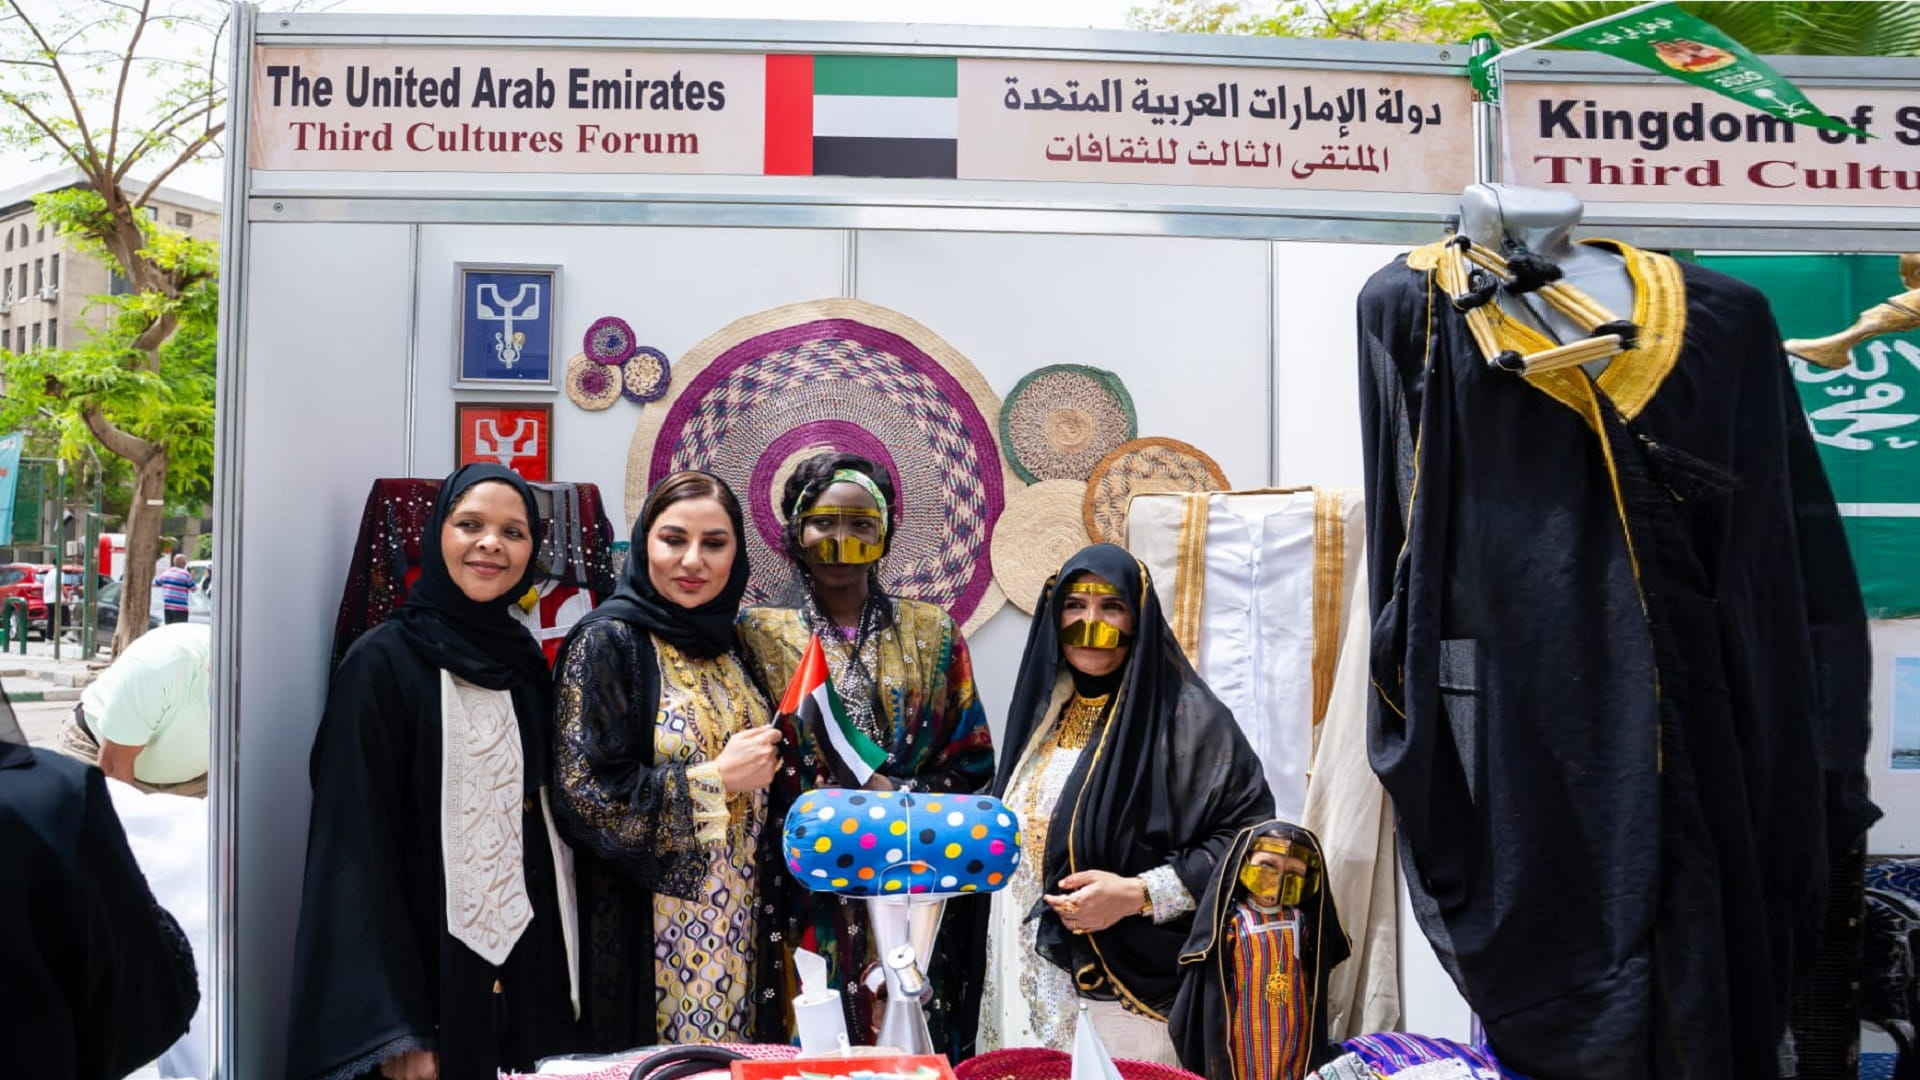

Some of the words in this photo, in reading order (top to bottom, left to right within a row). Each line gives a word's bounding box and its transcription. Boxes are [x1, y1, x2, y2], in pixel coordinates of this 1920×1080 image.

[266, 66, 332, 108] The
[346, 66, 461, 109] United
[472, 67, 556, 110] Arab
[568, 68, 726, 112] Emirates
[1004, 76, 1122, 114] المتحدة
[1132, 79, 1239, 126] العربية
[1249, 86, 1366, 138] الإمارات
[1376, 88, 1442, 135] دولة
[1538, 99, 1794, 151] Kingdom
[1816, 105, 1874, 145] of
[289, 121, 393, 152] Third
[406, 122, 563, 153] Cultures
[577, 124, 699, 154] Forum
[1046, 133, 1177, 165] للثقافات
[1188, 140, 1281, 169] الثالث
[1291, 144, 1389, 180] الملتقى
[1533, 155, 1724, 187] Third
[1747, 160, 1920, 190] Cultu
